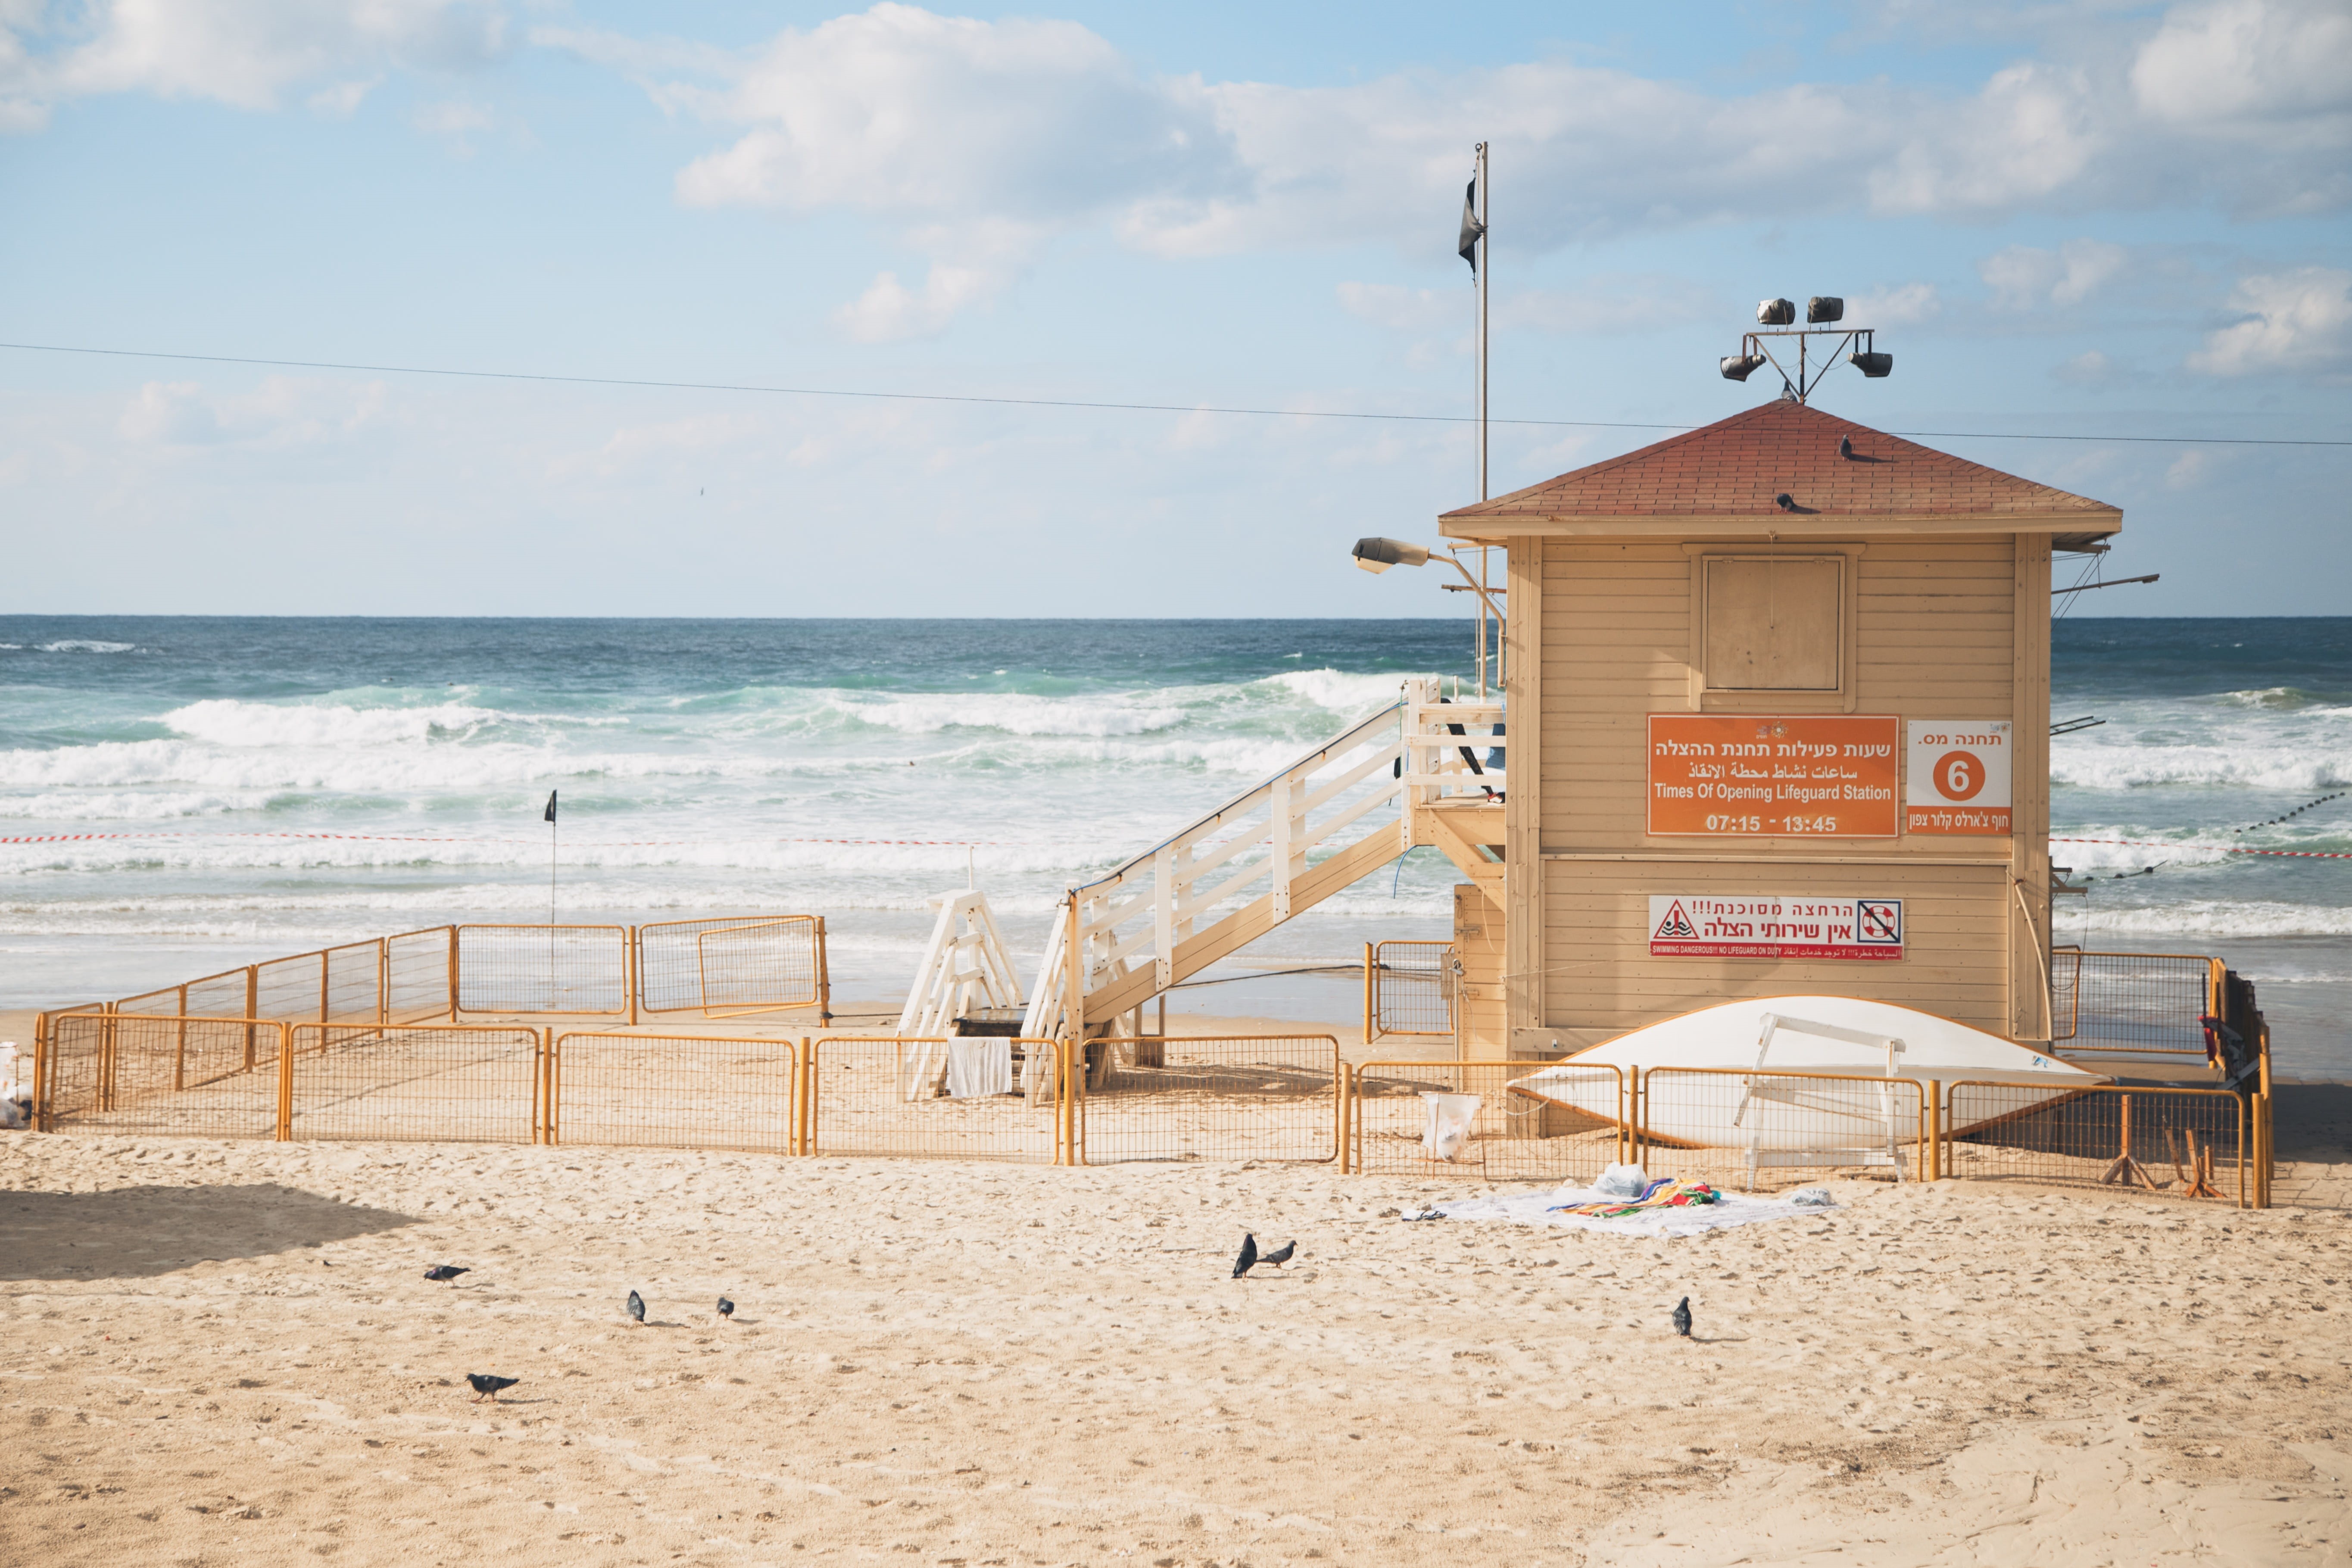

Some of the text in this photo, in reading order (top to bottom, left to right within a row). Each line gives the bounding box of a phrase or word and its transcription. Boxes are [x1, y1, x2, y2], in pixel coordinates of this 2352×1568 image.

[1918, 734, 2002, 745] תחנה מס.
[1656, 739, 1891, 758] שעות פעילות תחנת ההצלה
[1730, 761, 1769, 778] محطة
[1772, 763, 1807, 779] نشاط
[1811, 765, 1858, 779] ساعات
[1947, 760, 1970, 792] 6
[1654, 782, 1891, 803] Times Of Opening Lifeguard Station
[1706, 814, 1761, 831] 07:15
[1782, 816, 1836, 832] 13:45
[1909, 814, 1928, 830] צפון
[1931, 810, 1952, 830] קלור
[1992, 815, 2009, 831] חוף
[1693, 901, 1853, 916] הרחצה מסוכנת!!!
[1704, 916, 1851, 944] אין שירותי הצלה
[1653, 945, 1679, 954] SWIMMING
[1681, 945, 1718, 954] DANGEROUS!!!
[1728, 946, 1757, 954] LIFEGUARD
[1824, 949, 1840, 957] توجد
[1875, 949, 1900, 959] السباحة
